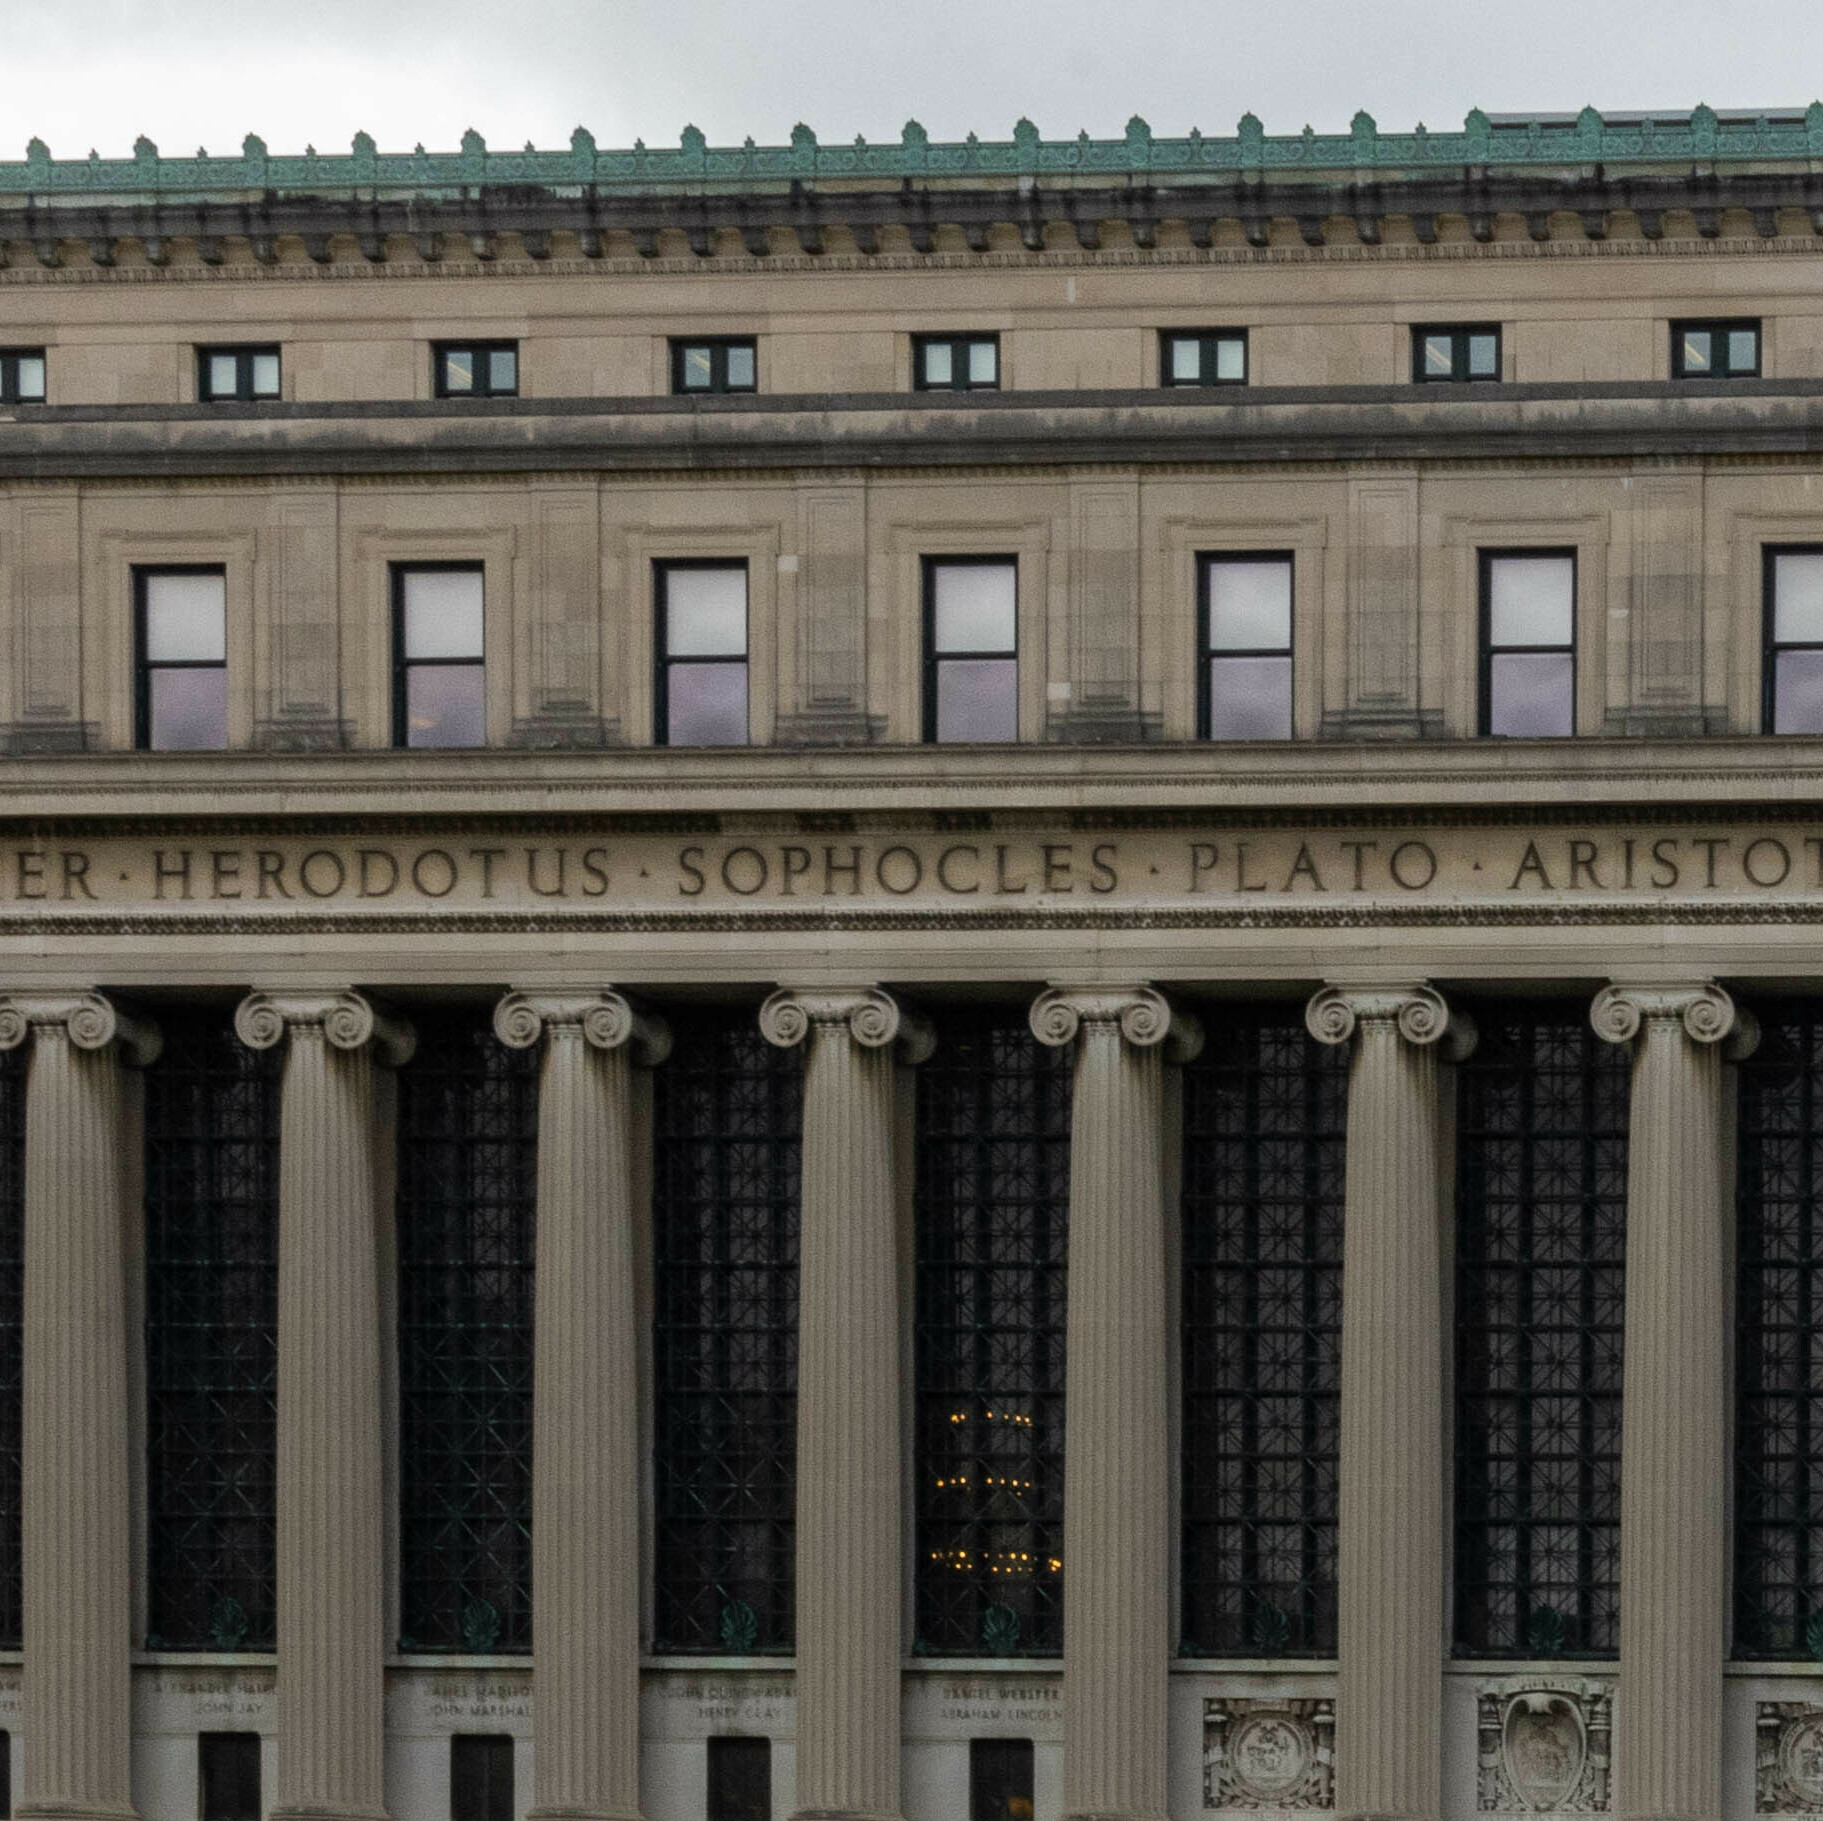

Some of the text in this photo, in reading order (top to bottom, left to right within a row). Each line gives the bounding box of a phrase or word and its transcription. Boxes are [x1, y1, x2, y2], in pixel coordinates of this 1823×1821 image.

[152, 846, 614, 899] HERODOTUS
[676, 843, 1121, 896] SOPHOCLES
[1186, 841, 1439, 895] PLATO
